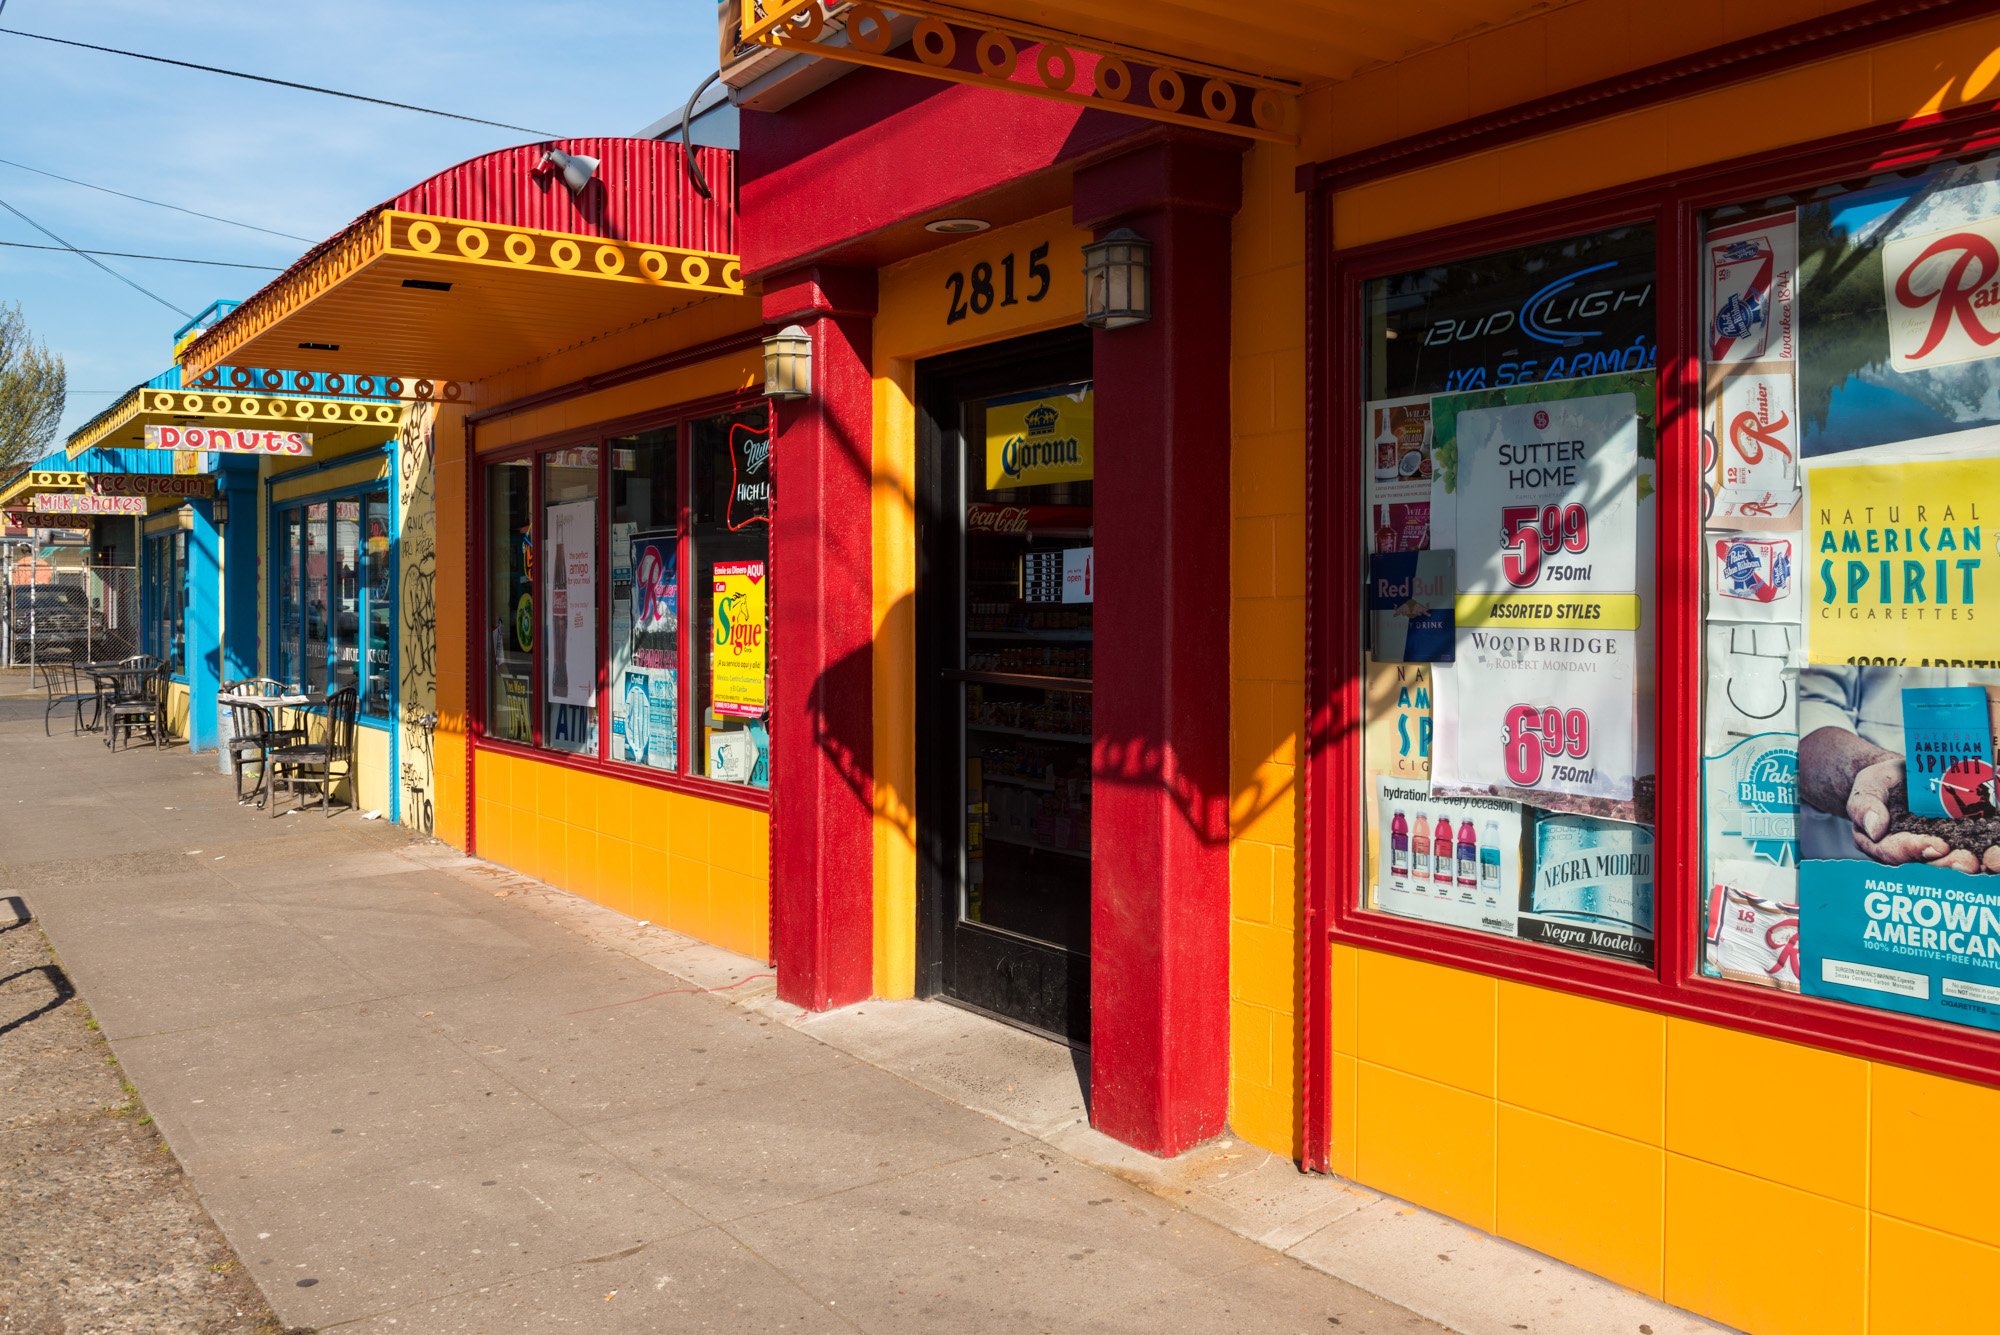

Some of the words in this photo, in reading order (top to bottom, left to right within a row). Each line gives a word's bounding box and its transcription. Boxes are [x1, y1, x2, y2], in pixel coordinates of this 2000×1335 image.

[945, 241, 1051, 326] 2815
[1776, 269, 1790, 303] 1844
[1424, 311, 1515, 346] BUD
[1721, 311, 1736, 336] Pabst
[1494, 360, 1538, 388] SE
[1729, 383, 1793, 465] Rainier
[1002, 433, 1080, 479] Corona
[1498, 440, 1586, 466] SUTTER
[1509, 465, 1576, 489] HOME
[1727, 467, 1738, 484] 12
[38, 494, 72, 512] Milk
[737, 483, 759, 502] HIGH
[1821, 502, 1980, 526] NATURAL
[1820, 525, 1982, 554] AMERICAN
[569, 563, 589, 577] amigo
[1066, 574, 1082, 584] open
[1546, 564, 1592, 582] 750ml
[716, 583, 725, 592] Con
[1378, 576, 1409, 598] Red
[1413, 576, 1445, 597] Bull
[1820, 558, 1982, 605] SPIRIT
[1489, 604, 1553, 619] ASSORTED
[1556, 603, 1602, 620] STYLES
[1822, 607, 1975, 621] CIGARETTES
[716, 597, 762, 656] Sigue
[1416, 621, 1443, 630] DRINK
[1471, 632, 1617, 655] WOODBRIDGE
[1542, 660, 1597, 673] MONDAVI
[1915, 741, 1982, 753] AMERICAN
[1551, 764, 1595, 785] 750ml
[1916, 754, 1982, 775] SPIRIT
[1384, 785, 1428, 803] hydration
[1470, 797, 1513, 813] occasion
[1741, 783, 1776, 803] Blue
[1543, 858, 1592, 891] NEGRA
[1595, 853, 1651, 878] MODELO
[1864, 879, 1903, 894] MADE
[1907, 884, 1942, 899] WITH
[1737, 909, 1756, 923] 18
[1864, 892, 2000, 936] GROWN
[1541, 922, 1585, 943] Negra
[1863, 920, 2000, 959] AMERICAN
[1864, 940, 1890, 952] 100%
[1892, 945, 1970, 965] ADDITIVE-FREE
[1957, 988, 1968, 996] NOT
[1940, 999, 1987, 1014] CIGARETTES
